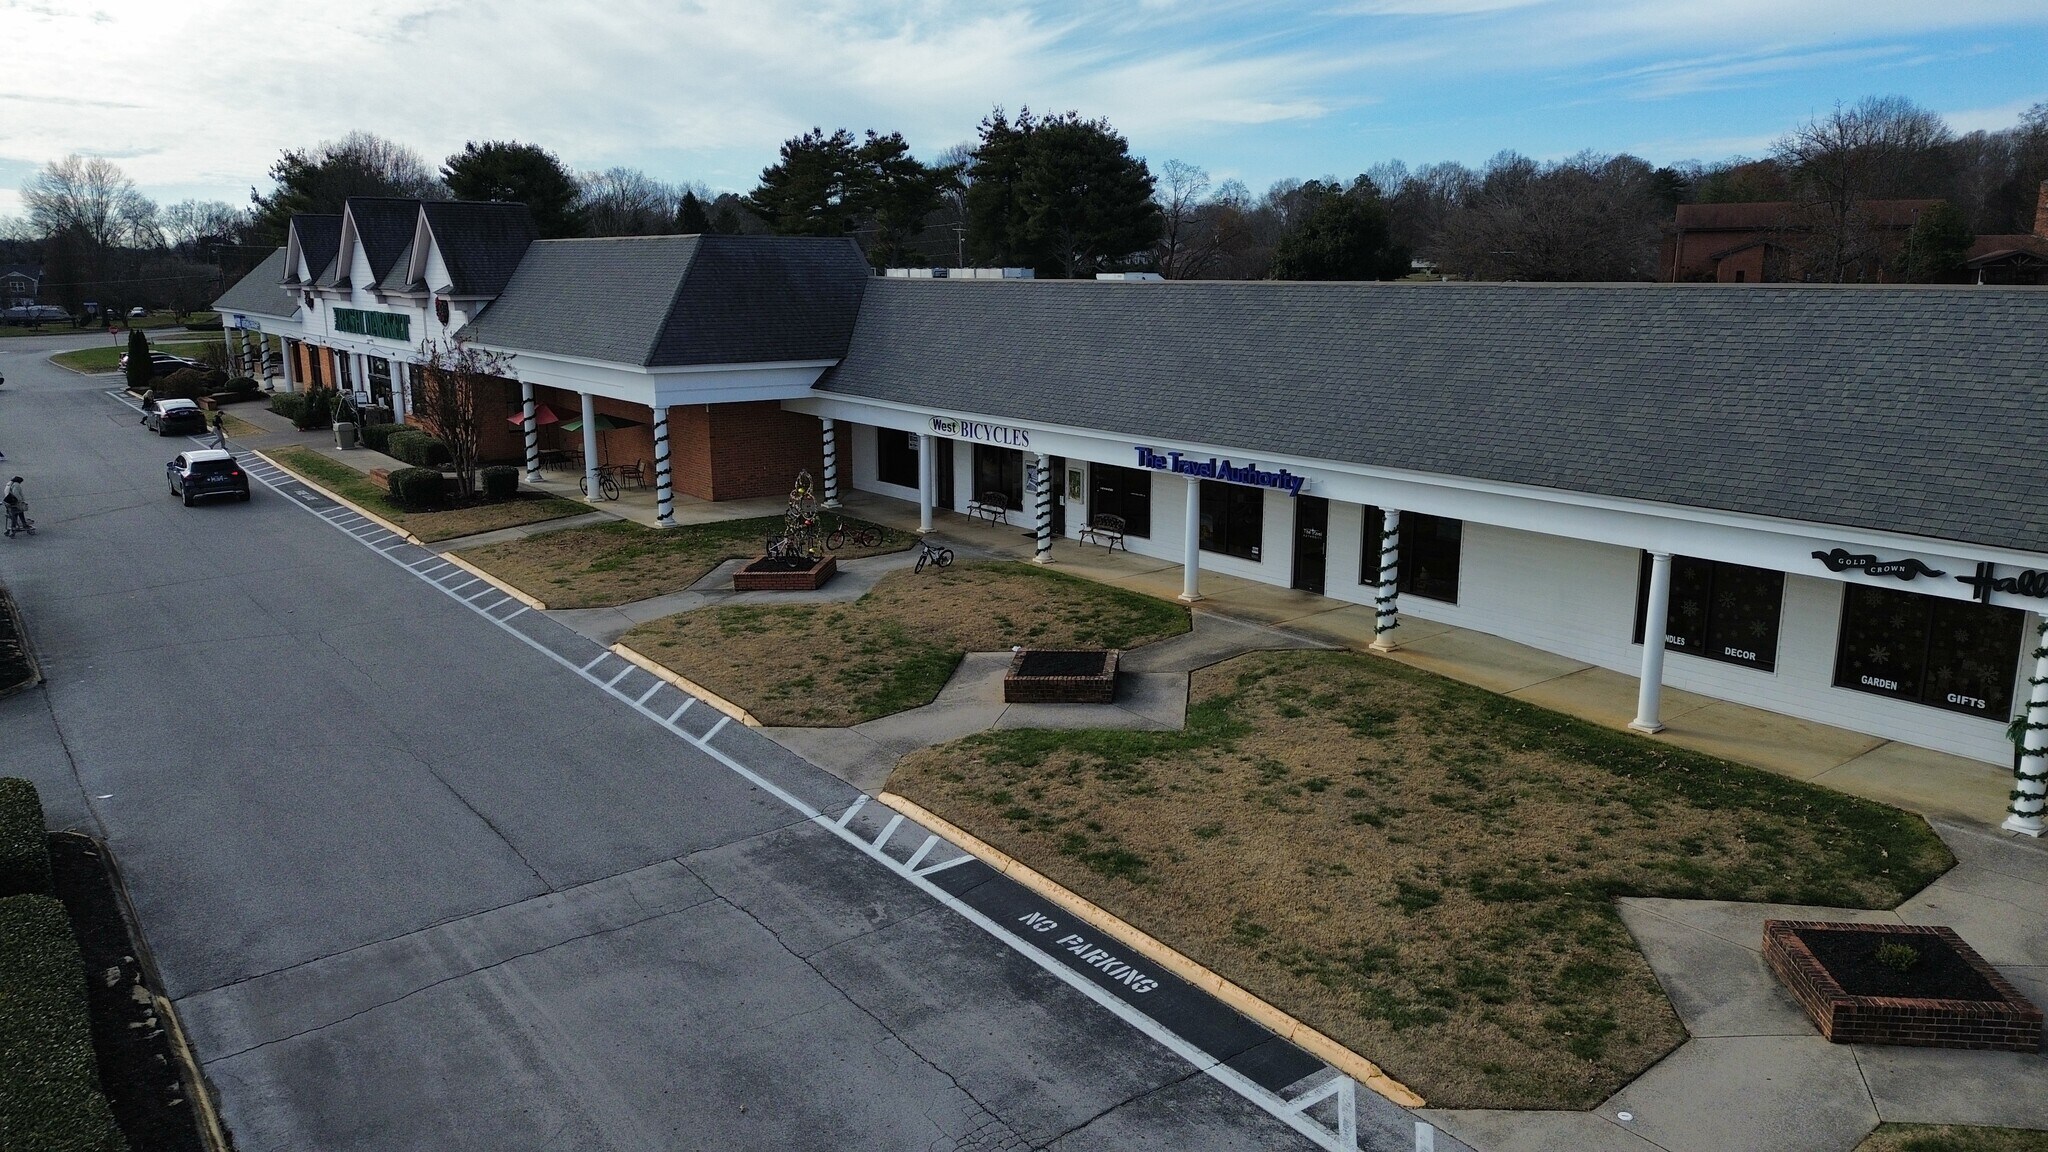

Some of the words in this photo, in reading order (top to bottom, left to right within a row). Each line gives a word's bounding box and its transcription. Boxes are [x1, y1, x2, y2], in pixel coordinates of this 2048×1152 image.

[932, 418, 957, 434] West
[960, 420, 1030, 447] BICYCLES
[1134, 446, 1168, 470] The
[1168, 451, 1217, 478] Travel
[1216, 459, 1305, 497] Authority
[1838, 557, 1867, 566] GOLD
[1870, 565, 1906, 574] CROWN
[1724, 646, 1756, 661] DECOR
[1861, 674, 1898, 691] GARDEN
[1946, 693, 1986, 709] GIFTS
[1018, 911, 1058, 932] NO
[1055, 933, 1159, 993] PARKING
